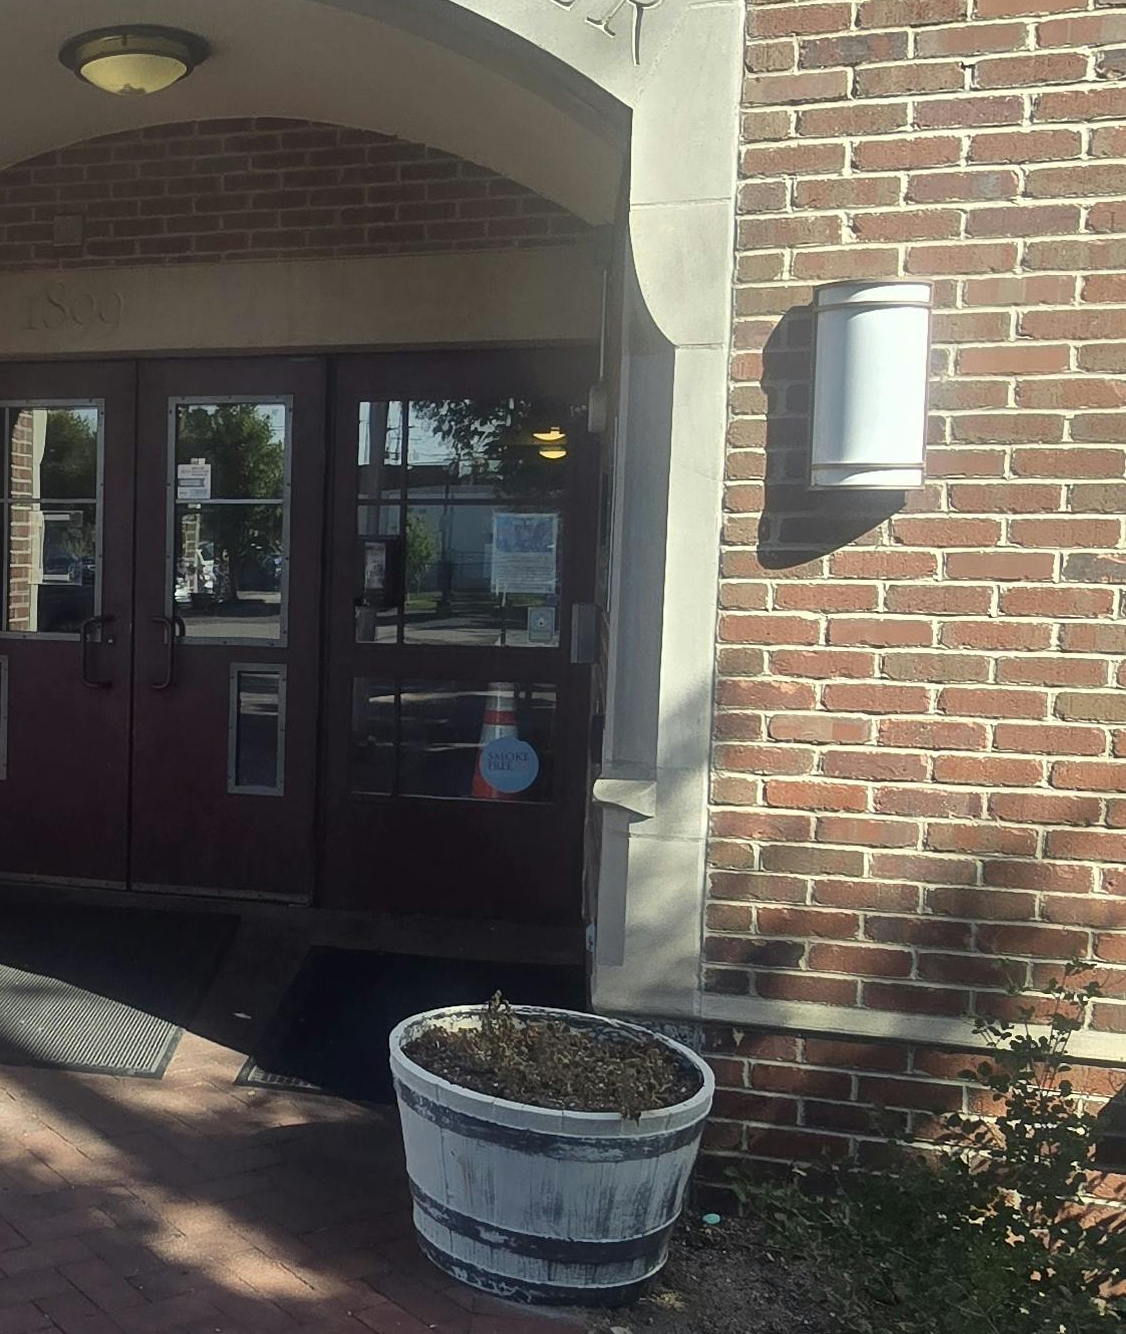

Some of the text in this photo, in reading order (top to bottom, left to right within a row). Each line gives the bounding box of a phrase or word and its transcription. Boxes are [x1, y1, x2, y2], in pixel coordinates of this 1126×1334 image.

[21, 281, 124, 332] 1899
[488, 751, 529, 763] SMOKE
[488, 762, 514, 771] FREE
